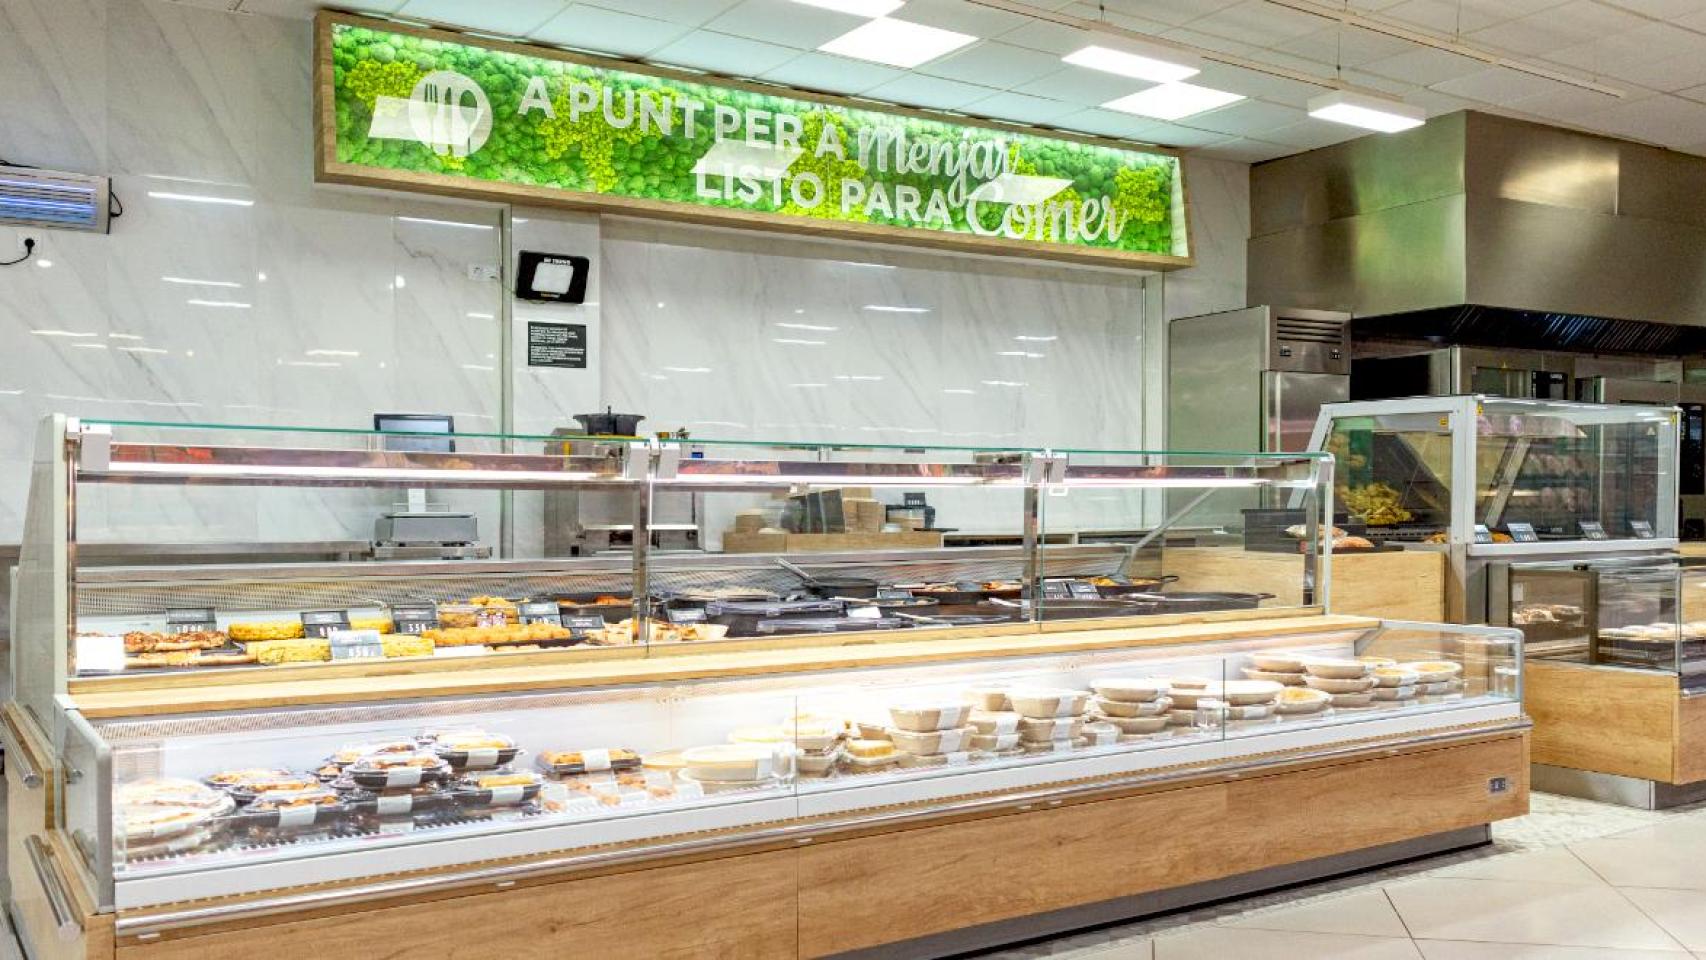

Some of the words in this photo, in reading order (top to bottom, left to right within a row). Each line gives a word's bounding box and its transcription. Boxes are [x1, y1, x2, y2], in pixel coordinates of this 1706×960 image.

[517, 76, 557, 120] A
[569, 82, 705, 139] PUNT
[714, 104, 804, 154] PER
[814, 123, 846, 161] A
[858, 125, 1020, 208] Menjar
[696, 159, 824, 208] LISTO
[841, 178, 952, 225] PARA
[966, 180, 1128, 242] Comer
